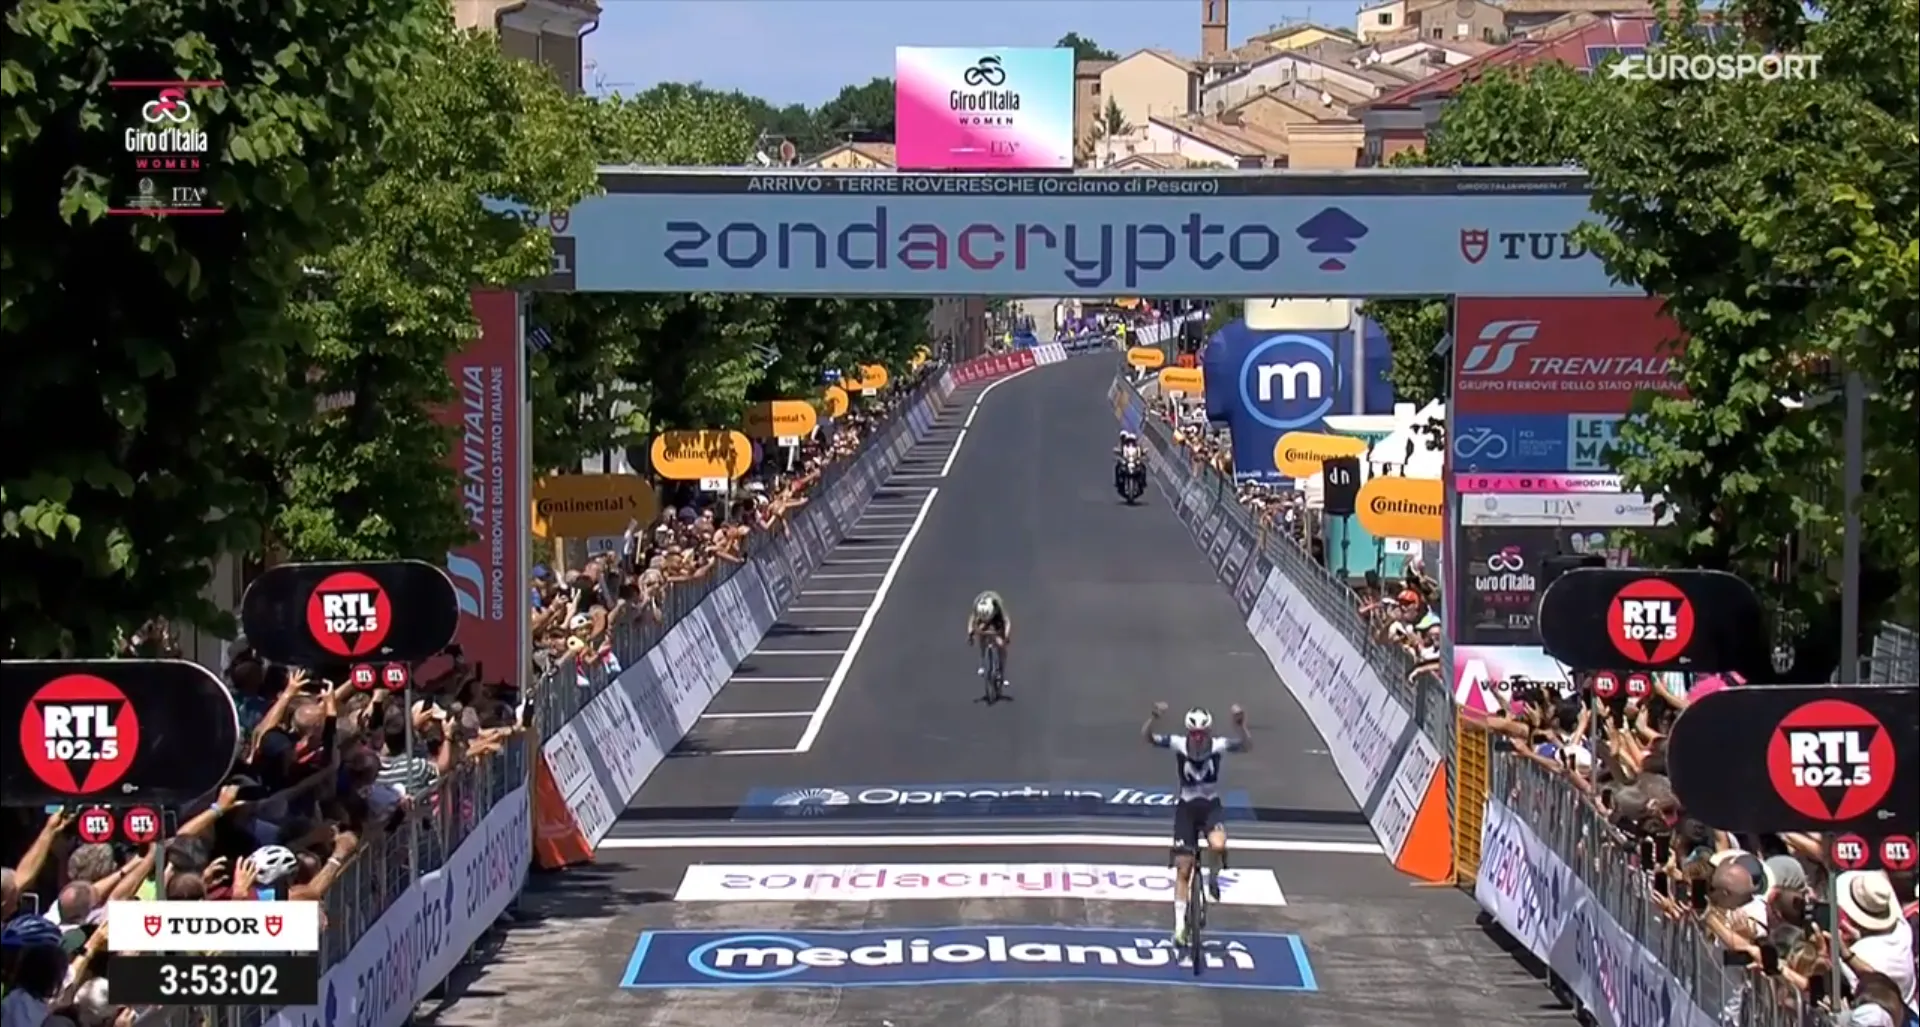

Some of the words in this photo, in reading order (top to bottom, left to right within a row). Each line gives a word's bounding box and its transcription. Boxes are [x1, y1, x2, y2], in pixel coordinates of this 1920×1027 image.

[950, 90, 976, 111] Giro
[979, 90, 1020, 111] d'Italia
[959, 117, 1014, 125] WOMEN
[748, 177, 821, 191] ARRIVO
[835, 177, 898, 192] TERRE
[902, 177, 1034, 193] ROVERESCHE
[1039, 178, 1120, 194] (Orciano
[1124, 178, 1142, 193] di
[1146, 178, 1219, 194] Pesaro)
[664, 206, 1280, 288] zondacrypto
[1500, 233, 1604, 260] TUD
[1458, 380, 1504, 391] GRUPPO
[1506, 380, 1556, 391] FERROVIE
[1561, 380, 1595, 391] DELLO
[1598, 380, 1632, 391] STATO
[463, 366, 485, 541] RENITALIA
[492, 424, 504, 462] STATO
[537, 496, 624, 518] Continental
[1397, 541, 1410, 551] 10
[323, 593, 376, 618] RTL
[492, 570, 504, 620] GRUPPO
[1623, 600, 1677, 624] RTL
[325, 617, 378, 633] 102.5
[1623, 625, 1677, 640] 102.5
[44, 705, 117, 738] RTL
[44, 739, 119, 760] 102.5
[1790, 731, 1869, 764] RTL
[1791, 765, 1872, 787] 102.5
[720, 869, 1175, 891] zondacrypto
